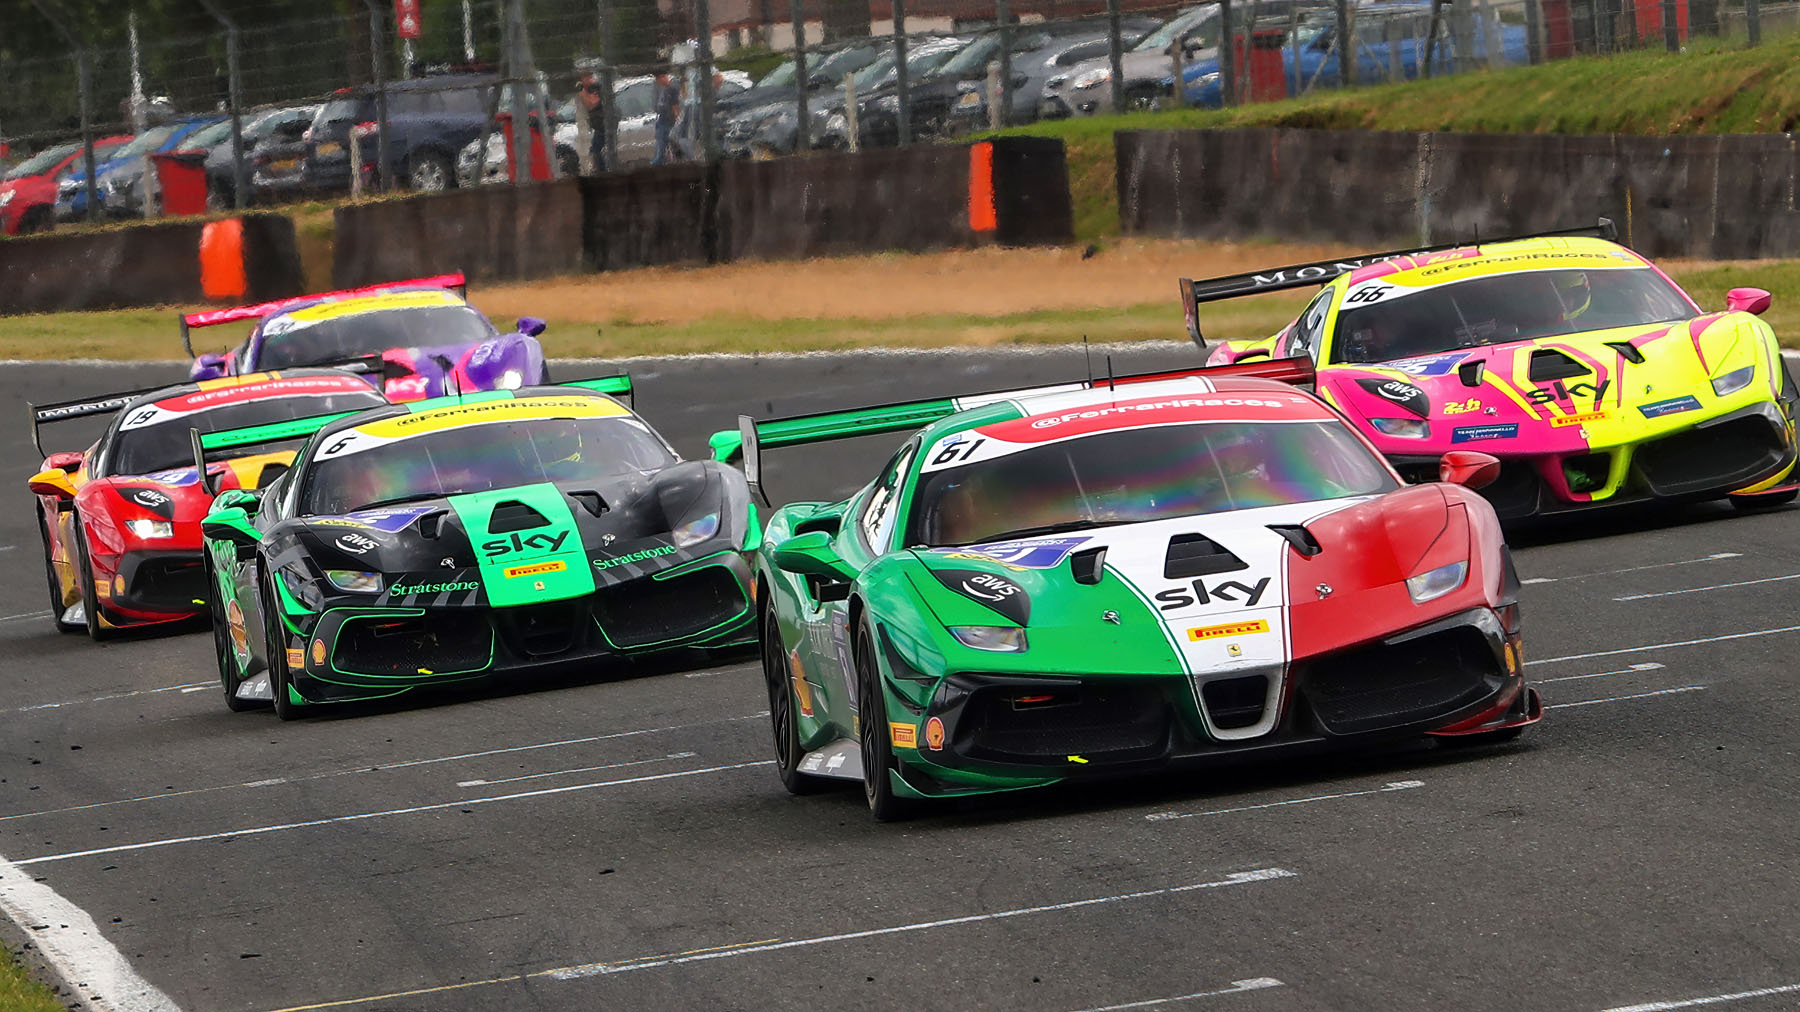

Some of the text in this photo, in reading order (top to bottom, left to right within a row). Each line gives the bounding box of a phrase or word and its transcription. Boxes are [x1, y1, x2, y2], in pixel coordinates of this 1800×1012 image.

[1421, 252, 1607, 276] @FerrariRaces
[1347, 286, 1394, 303] 66
[1384, 381, 1422, 398] aws
[1526, 379, 1611, 405] sky
[127, 410, 157, 426] 19
[397, 402, 588, 427] @FerrariRaces
[1031, 399, 1283, 429] @FerrariRaces
[325, 437, 357, 454] 6
[932, 439, 986, 465] 61
[141, 489, 169, 503] aws
[342, 533, 379, 551] aws
[481, 530, 570, 557] sky
[592, 544, 677, 570] Stratstone
[510, 563, 560, 576] PIRELLI
[389, 579, 479, 597] Stratstone
[971, 573, 1021, 596] aws
[1155, 577, 1271, 611] sky
[1194, 622, 1261, 638] PIRELLI
